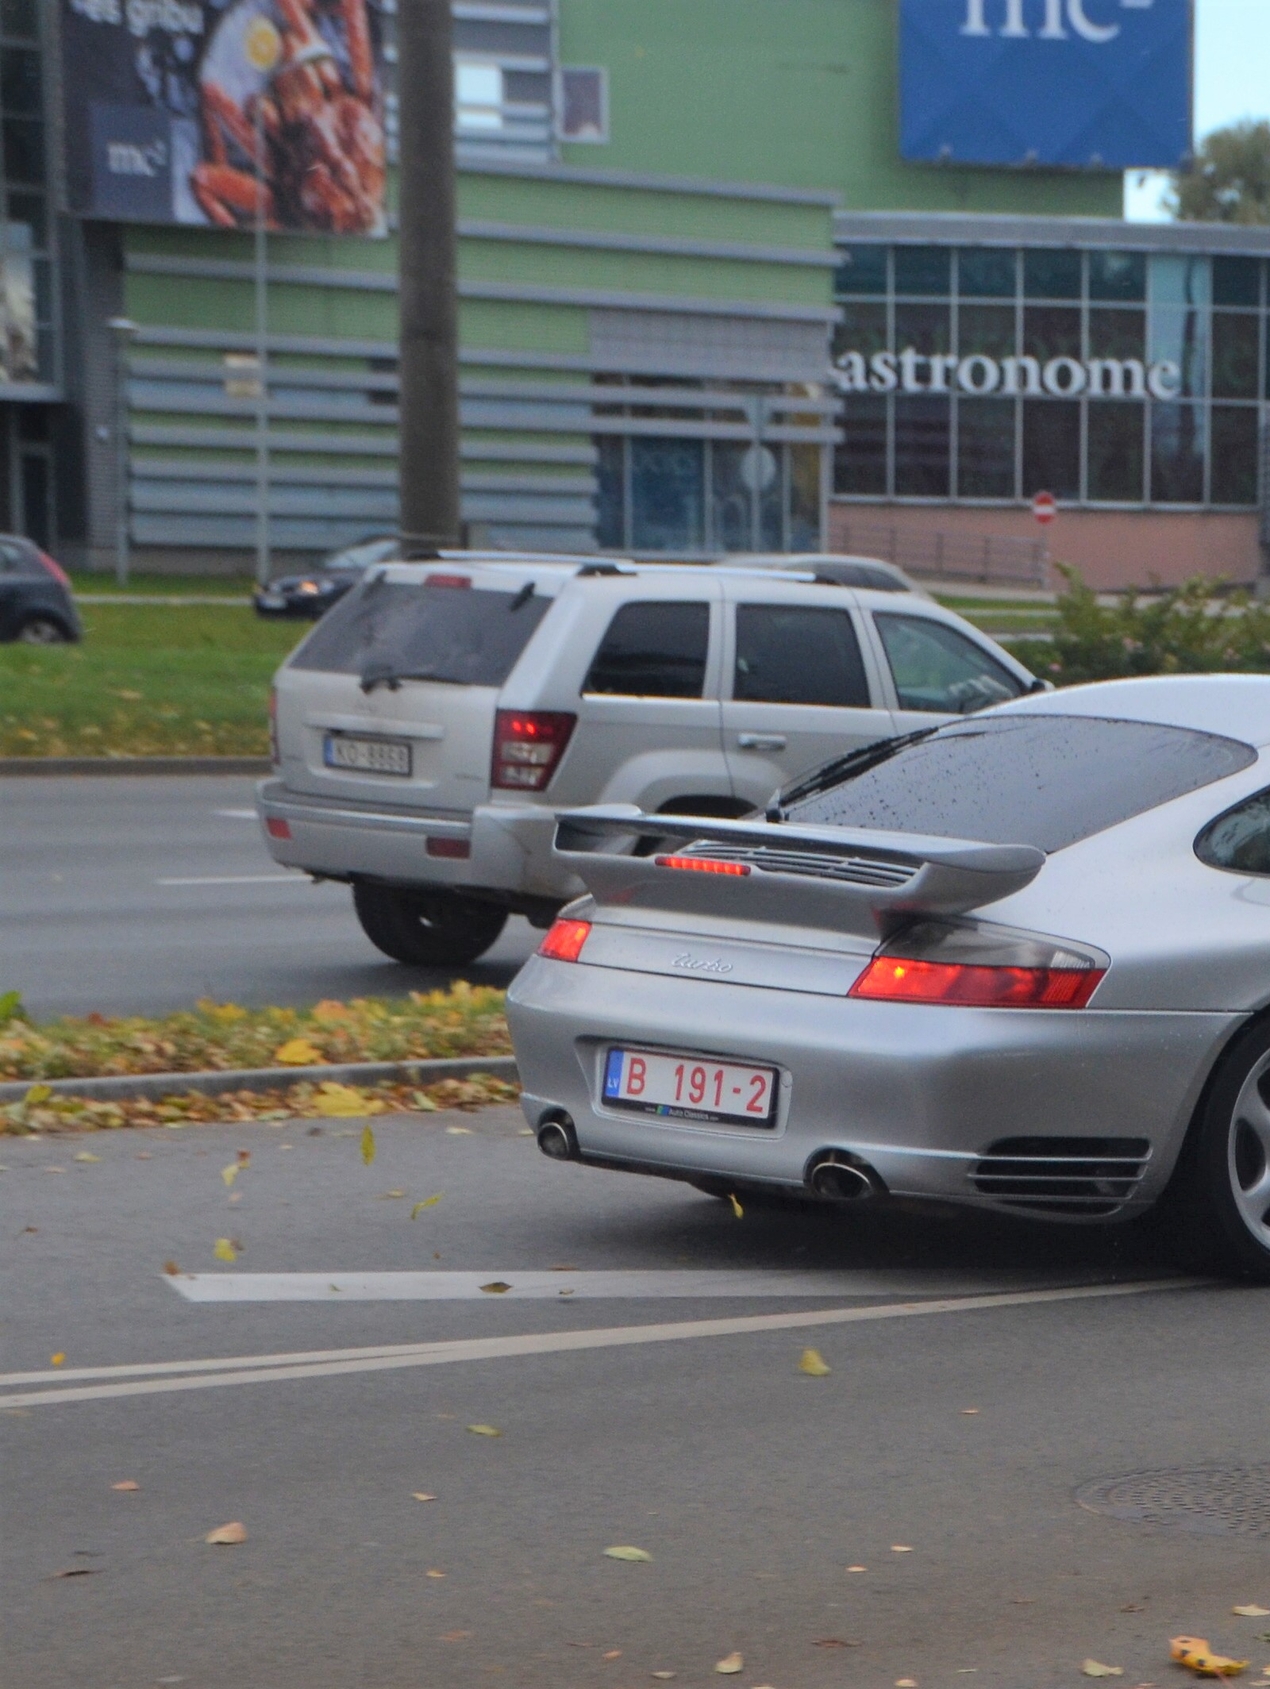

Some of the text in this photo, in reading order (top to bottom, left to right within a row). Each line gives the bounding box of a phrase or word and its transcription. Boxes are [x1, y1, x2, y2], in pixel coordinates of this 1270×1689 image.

[829, 348, 1182, 399] astronome
[671, 953, 733, 973] turbo
[626, 1057, 766, 1113] B 191-2
